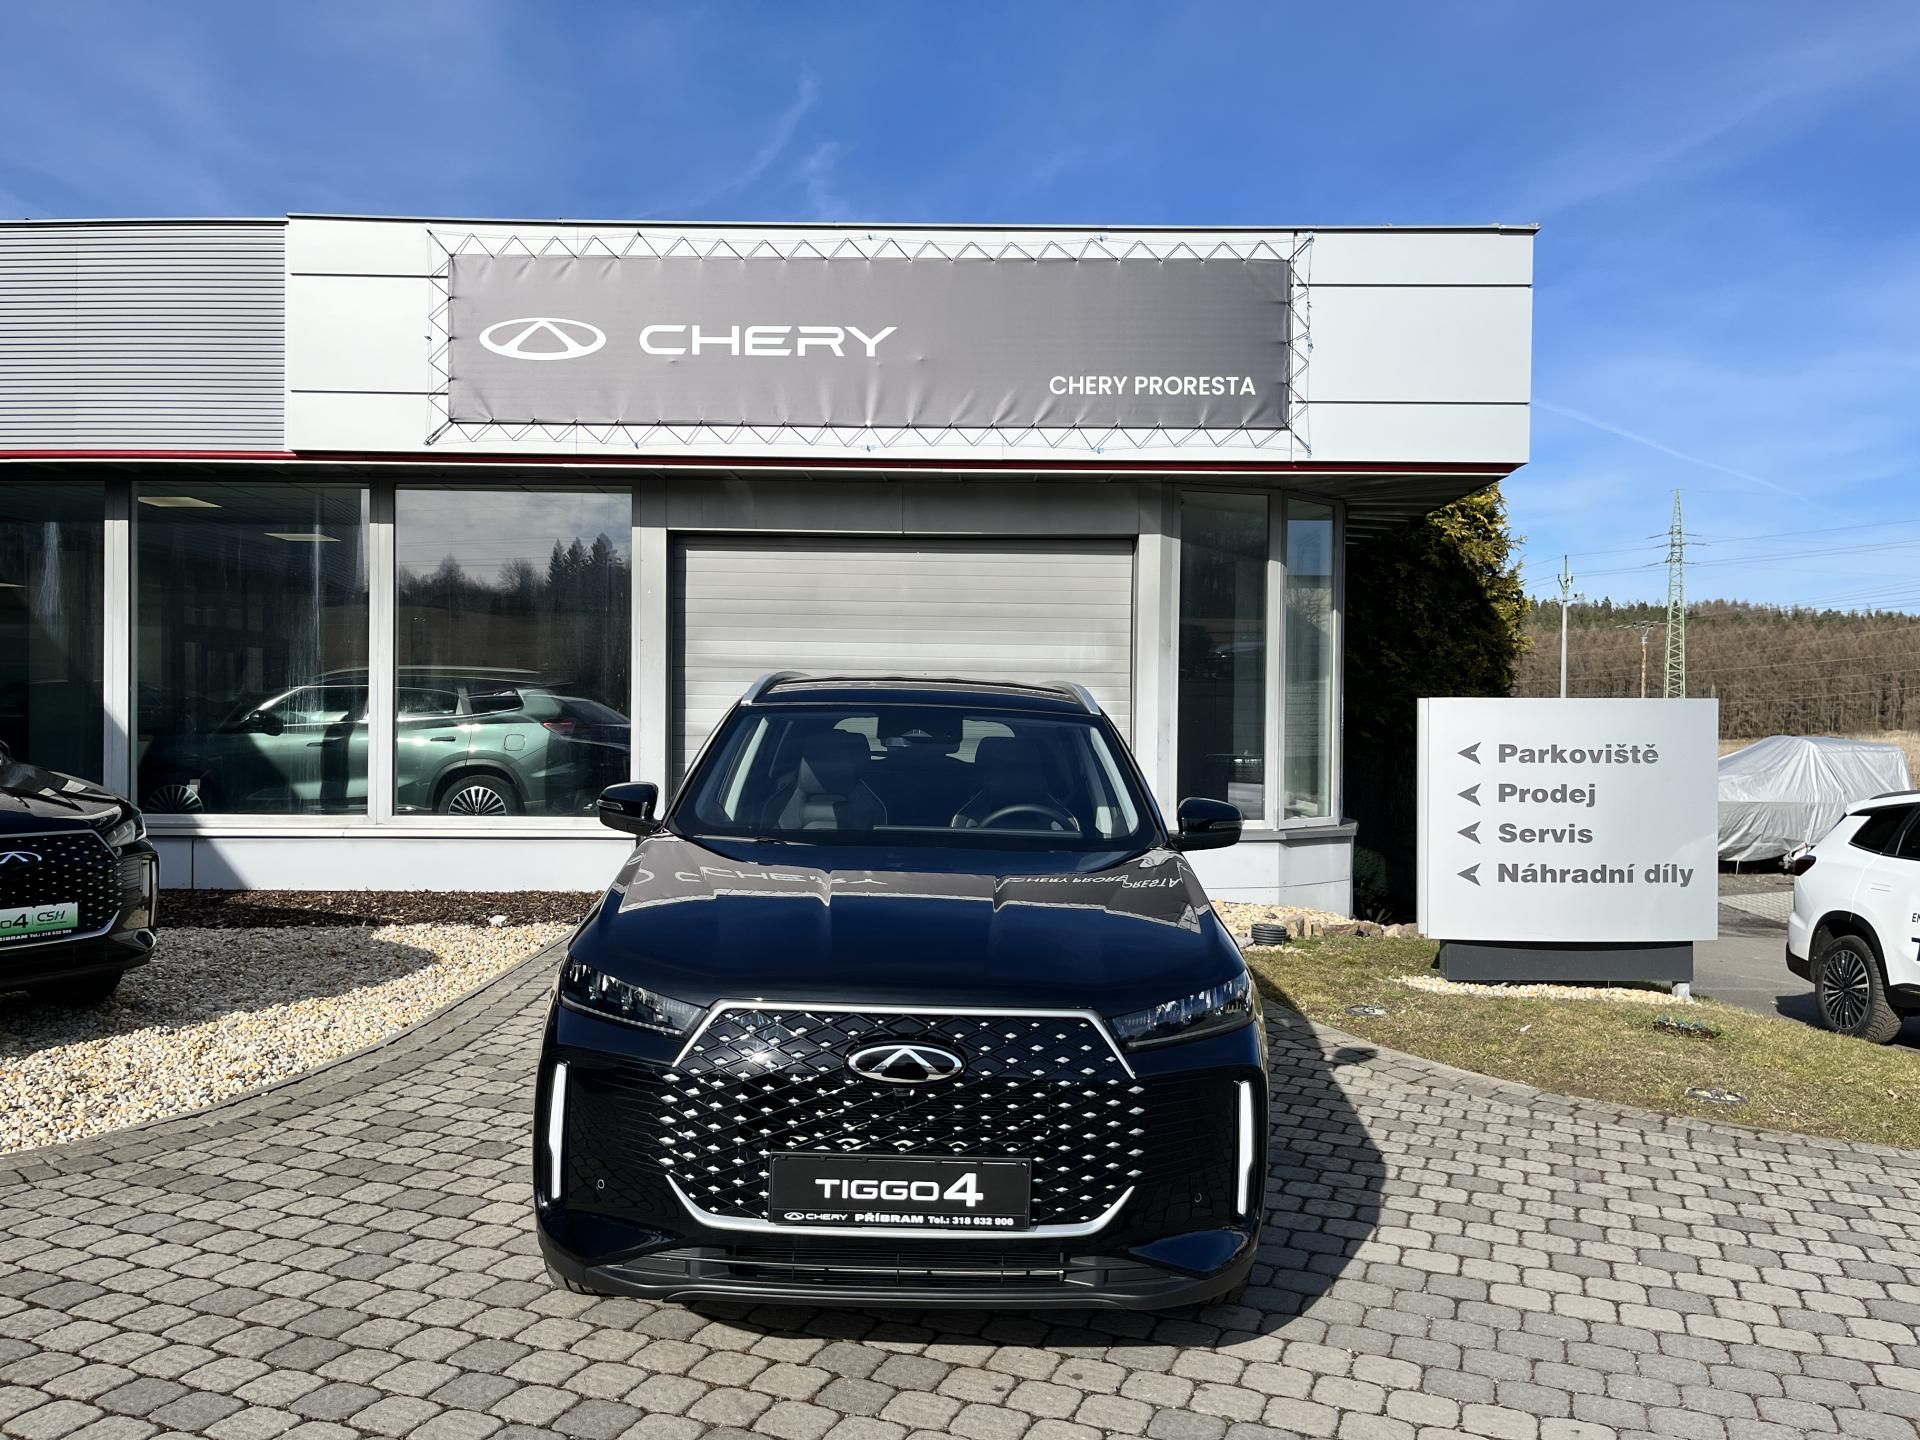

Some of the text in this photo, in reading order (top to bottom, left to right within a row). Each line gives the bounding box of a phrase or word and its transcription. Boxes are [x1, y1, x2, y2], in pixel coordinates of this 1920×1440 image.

[638, 324, 898, 358] CHERY
[1048, 375, 1257, 397] CHERY PRORESTA
[1498, 743, 1659, 764] Parkoviště
[1498, 783, 1596, 808] Prodej
[1498, 823, 1594, 844] Servis
[1497, 863, 1694, 888] Náhradní díly
[805, 1213, 849, 1222] CHERY
[854, 1212, 924, 1225] PŘÍBRAM
[927, 1215, 951, 1226] Tel.:
[951, 1216, 972, 1226] 318
[972, 1217, 993, 1227] 632
